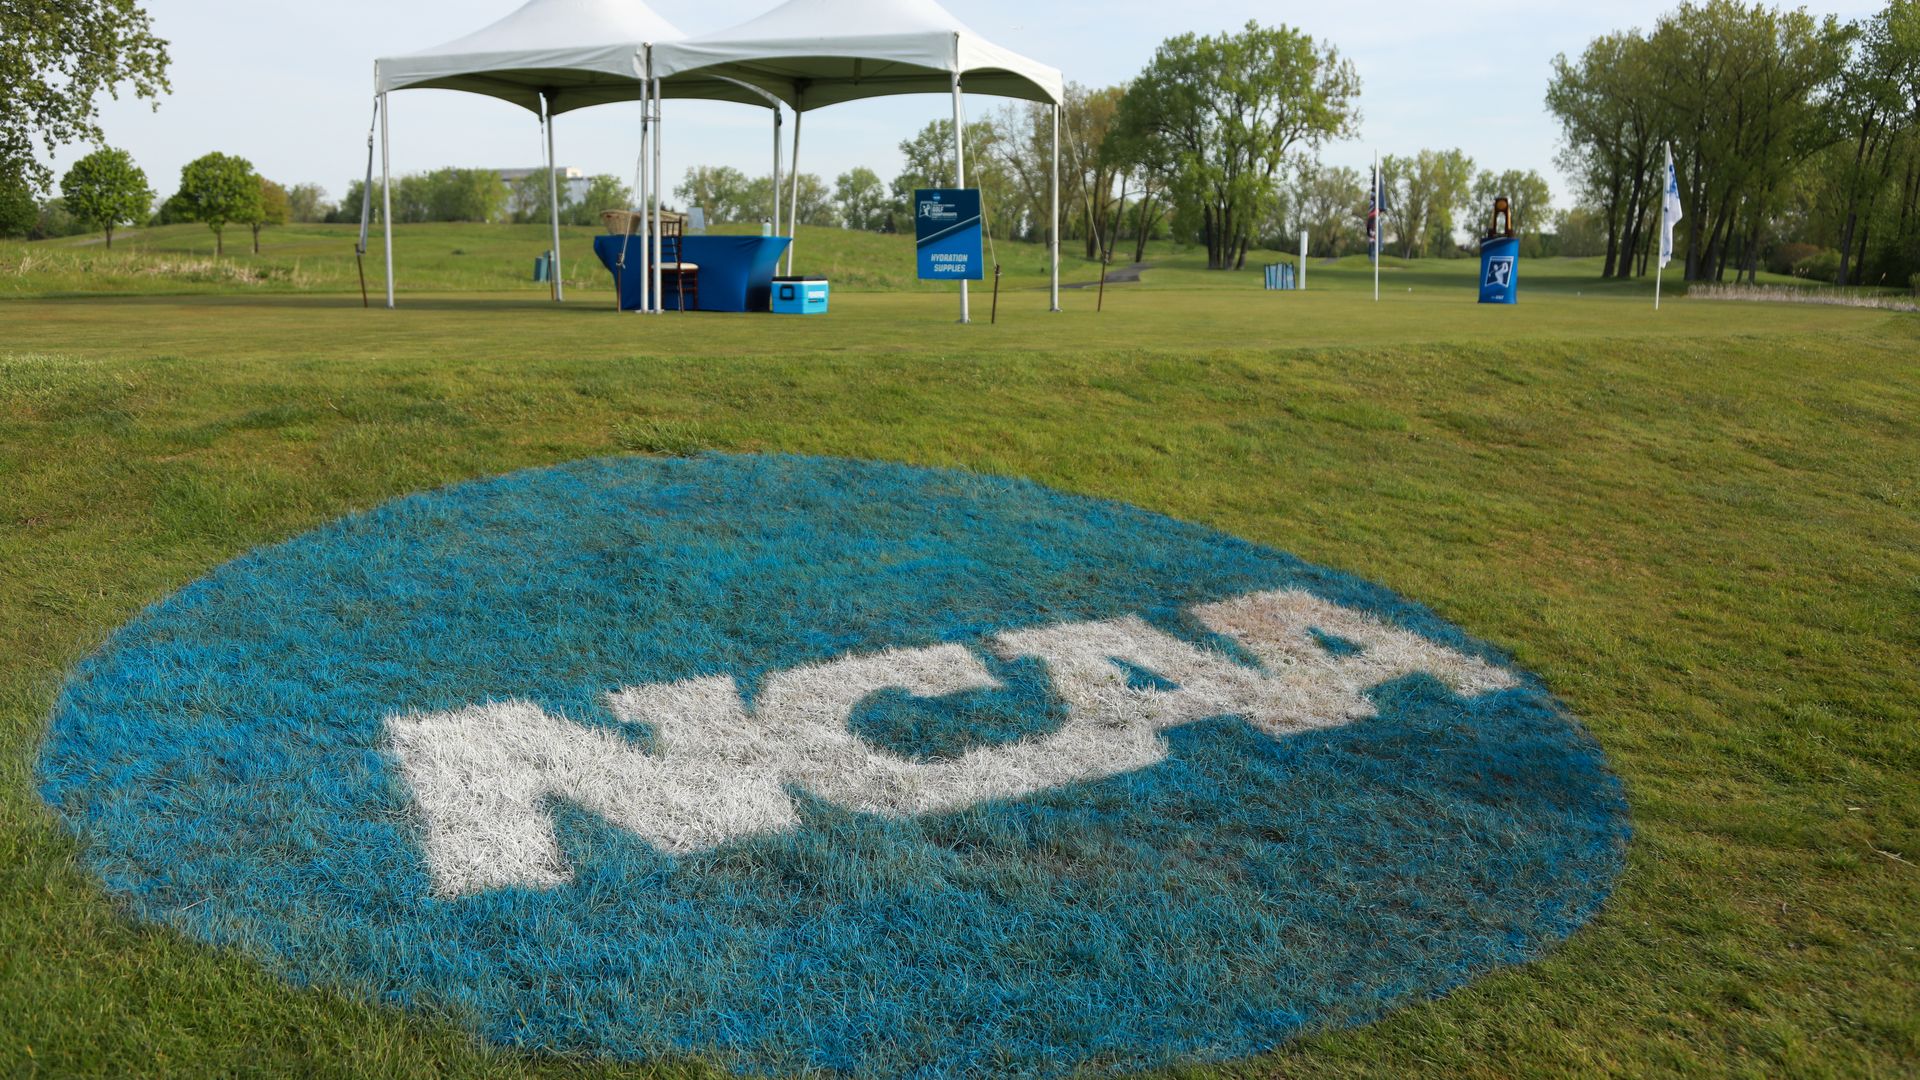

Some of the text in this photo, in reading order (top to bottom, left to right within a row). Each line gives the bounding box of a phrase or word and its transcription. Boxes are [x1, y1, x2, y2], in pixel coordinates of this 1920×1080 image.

[931, 253, 968, 262] HYDRATION
[934, 263, 966, 272] SUPPLIES
[385, 588, 1520, 899] NCAA
